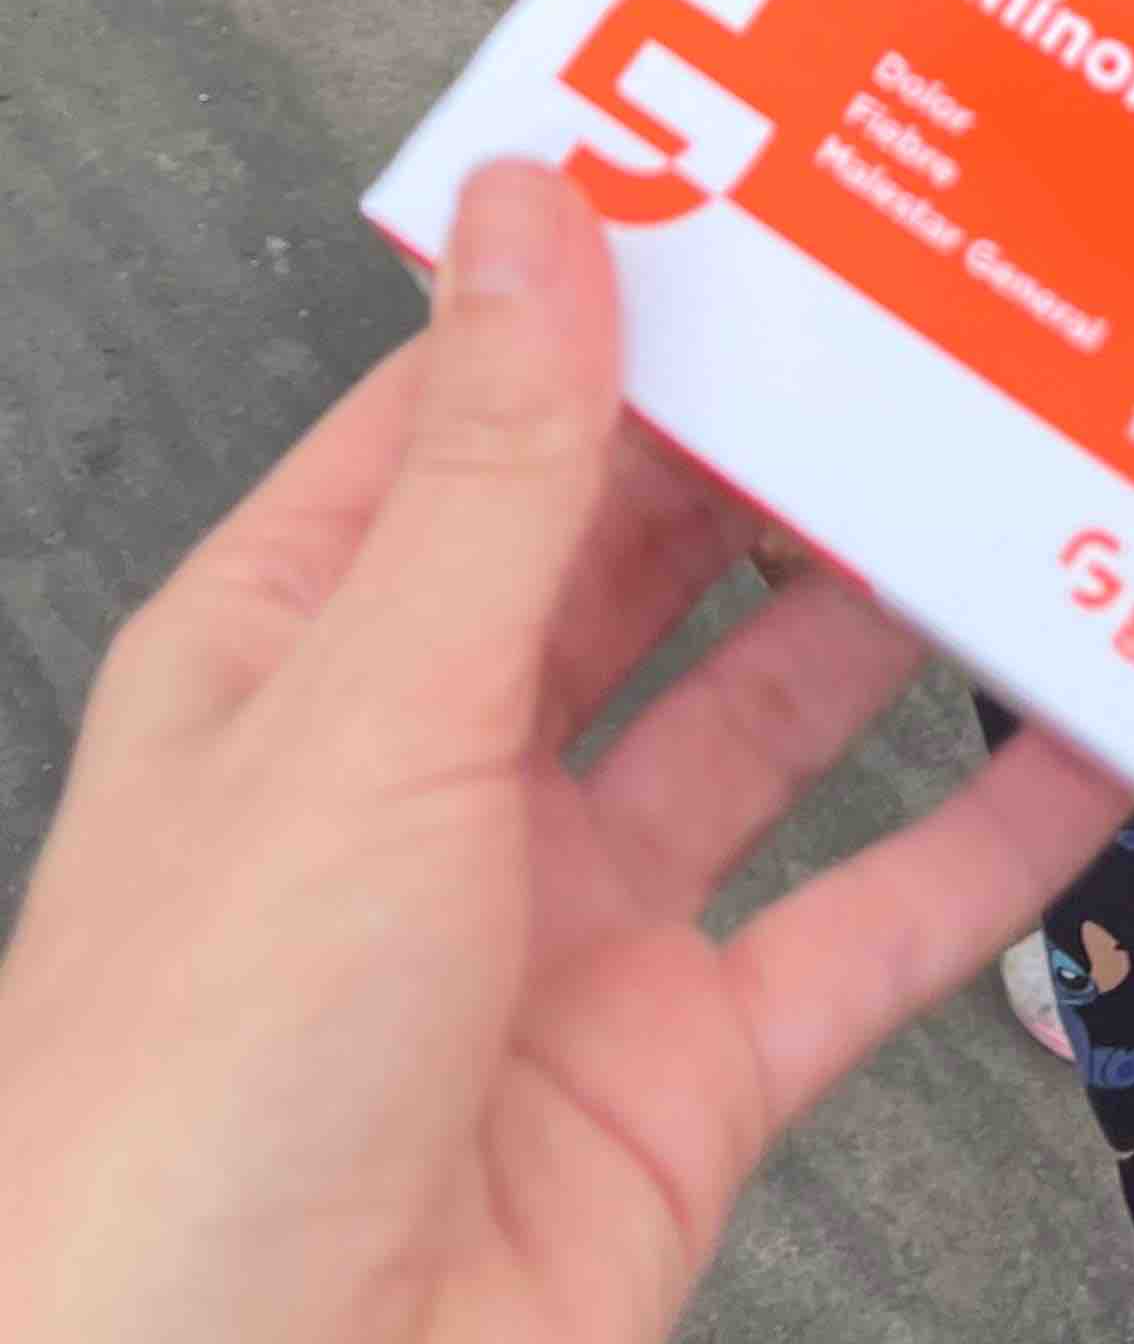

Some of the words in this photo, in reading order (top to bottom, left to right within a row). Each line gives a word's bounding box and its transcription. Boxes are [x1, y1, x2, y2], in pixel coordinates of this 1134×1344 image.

[843, 91, 961, 189] Fiebre
[872, 50, 976, 136] Dolor
[814, 133, 967, 255] Malestar
[964, 238, 1111, 354] General
